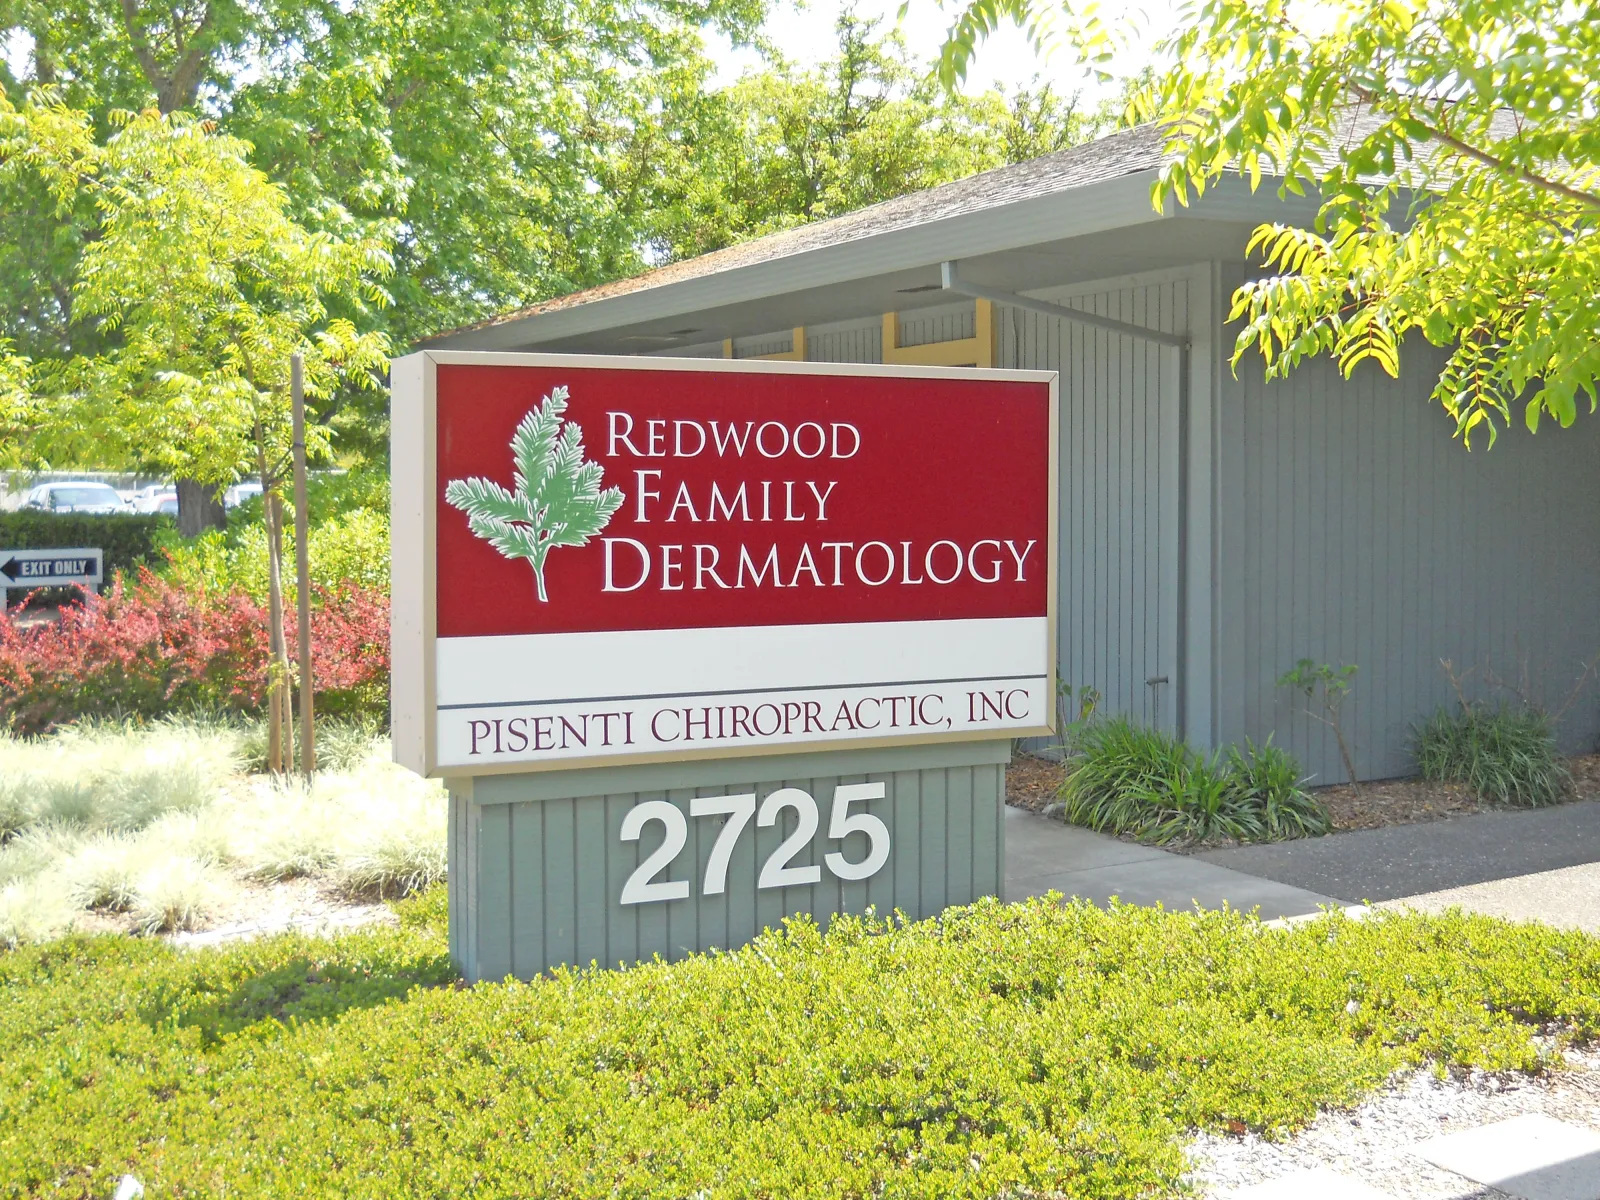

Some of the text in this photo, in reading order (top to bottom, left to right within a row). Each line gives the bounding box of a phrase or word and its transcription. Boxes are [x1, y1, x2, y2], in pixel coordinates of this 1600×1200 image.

[606, 411, 861, 459] REDWOOD
[633, 469, 838, 524] FAMILY
[21, 560, 87, 576] EXIT ONLY
[600, 537, 1037, 593] DERMATOLOGY
[469, 688, 1030, 755] PISENTI CHIROPRACTIC, INC
[620, 780, 892, 907] 2725
